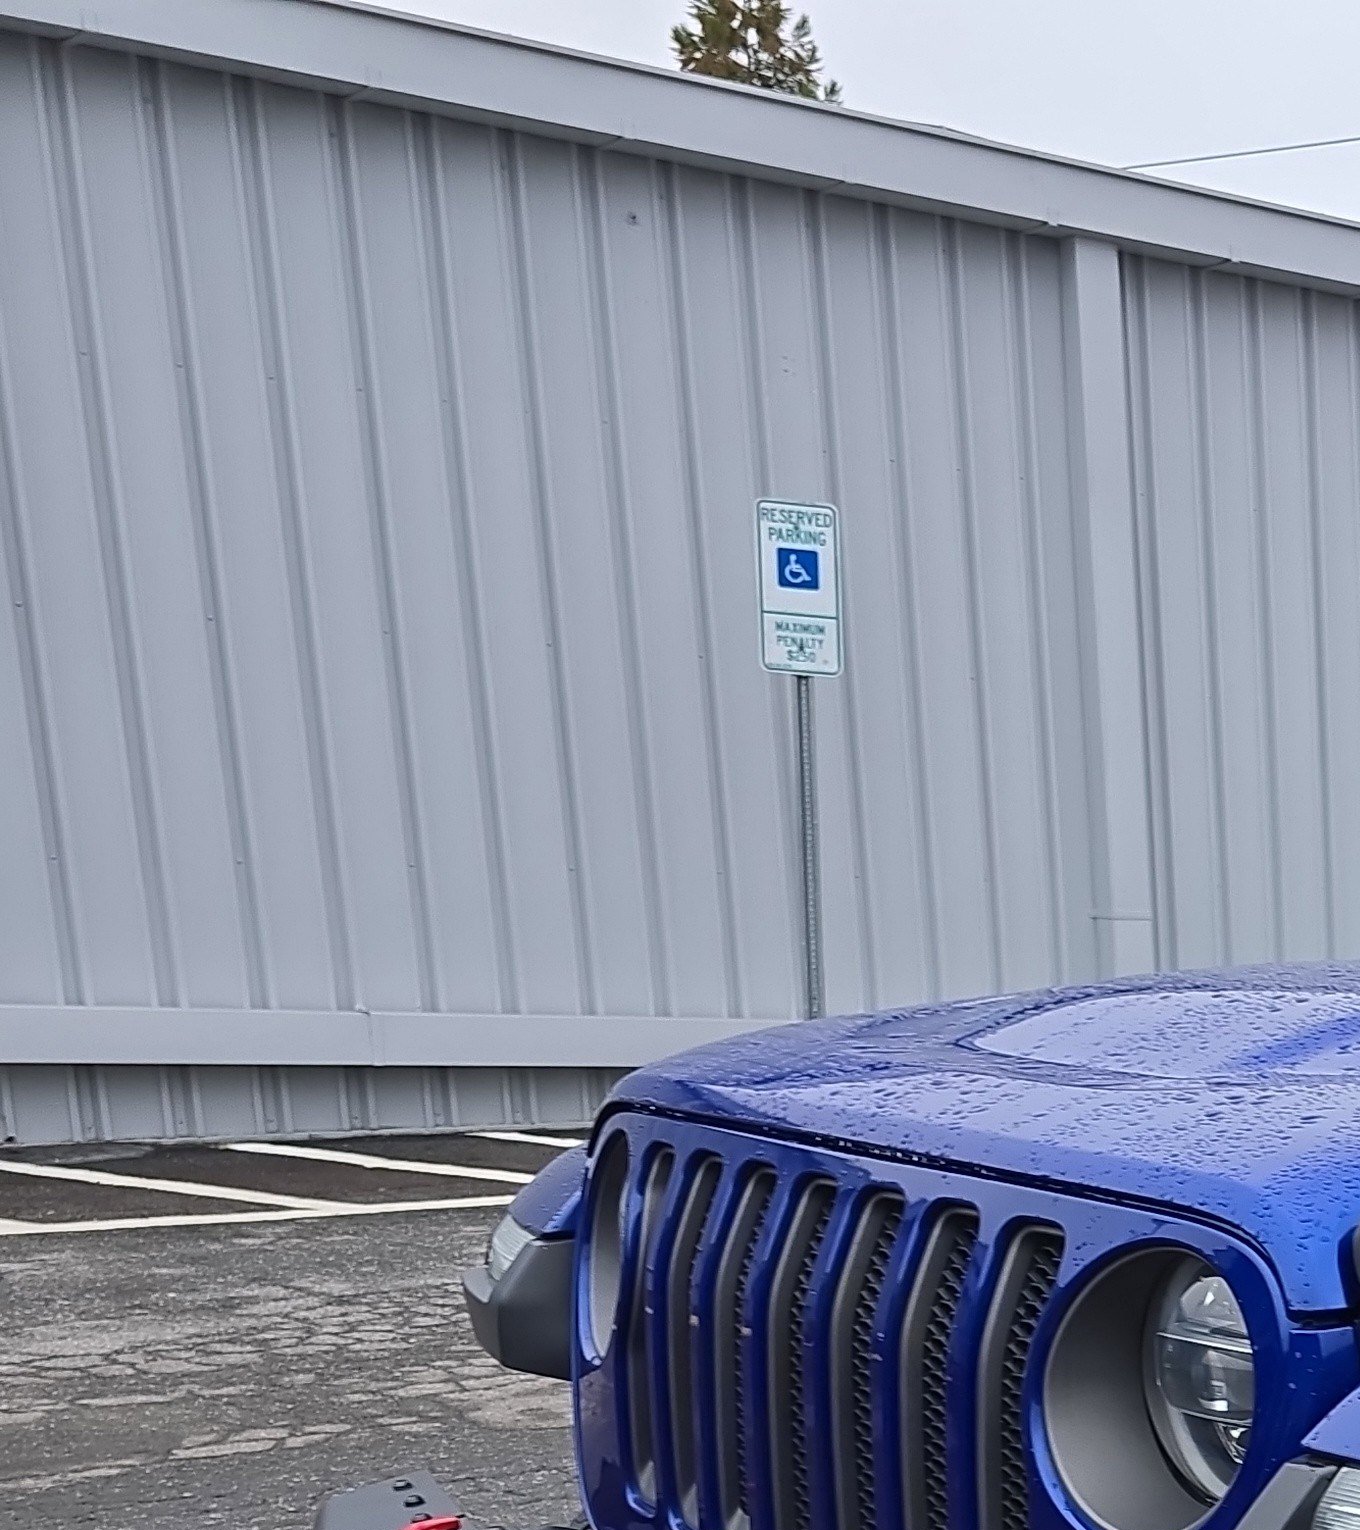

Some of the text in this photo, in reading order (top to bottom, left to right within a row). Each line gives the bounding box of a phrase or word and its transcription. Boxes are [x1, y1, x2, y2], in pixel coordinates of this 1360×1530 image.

[761, 507, 832, 528] RESERVED
[768, 527, 827, 546] PARKING
[775, 621, 826, 636] MAXIMUM
[776, 635, 824, 651] PENALTY
